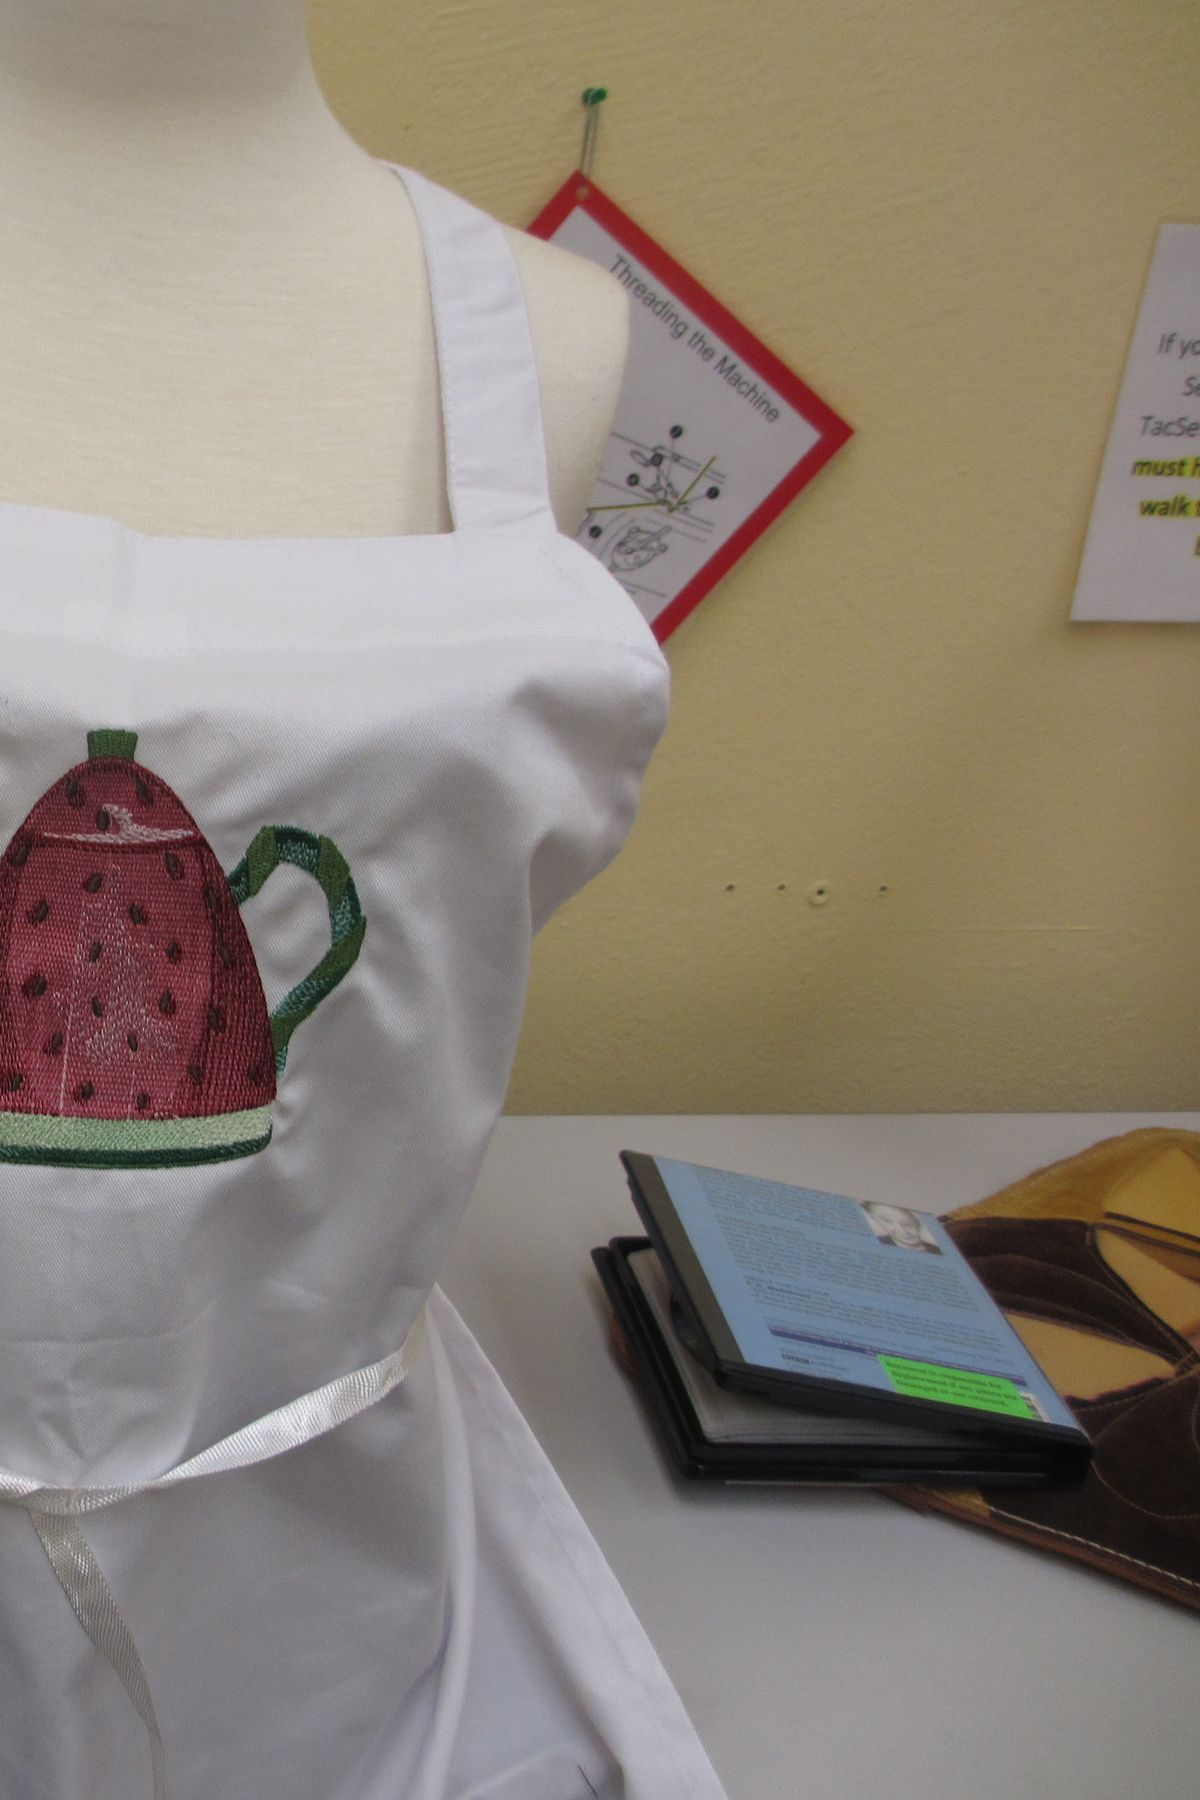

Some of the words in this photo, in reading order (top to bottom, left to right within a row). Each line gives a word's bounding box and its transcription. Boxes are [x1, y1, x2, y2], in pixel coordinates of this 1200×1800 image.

[610, 255, 689, 339] Threading
[687, 331, 715, 362] the
[713, 355, 780, 423] Machine
[1158, 332, 1177, 353] If
[1140, 415, 1200, 437] TacSe
[1130, 459, 1186, 476] must
[1140, 495, 1188, 516] walk
